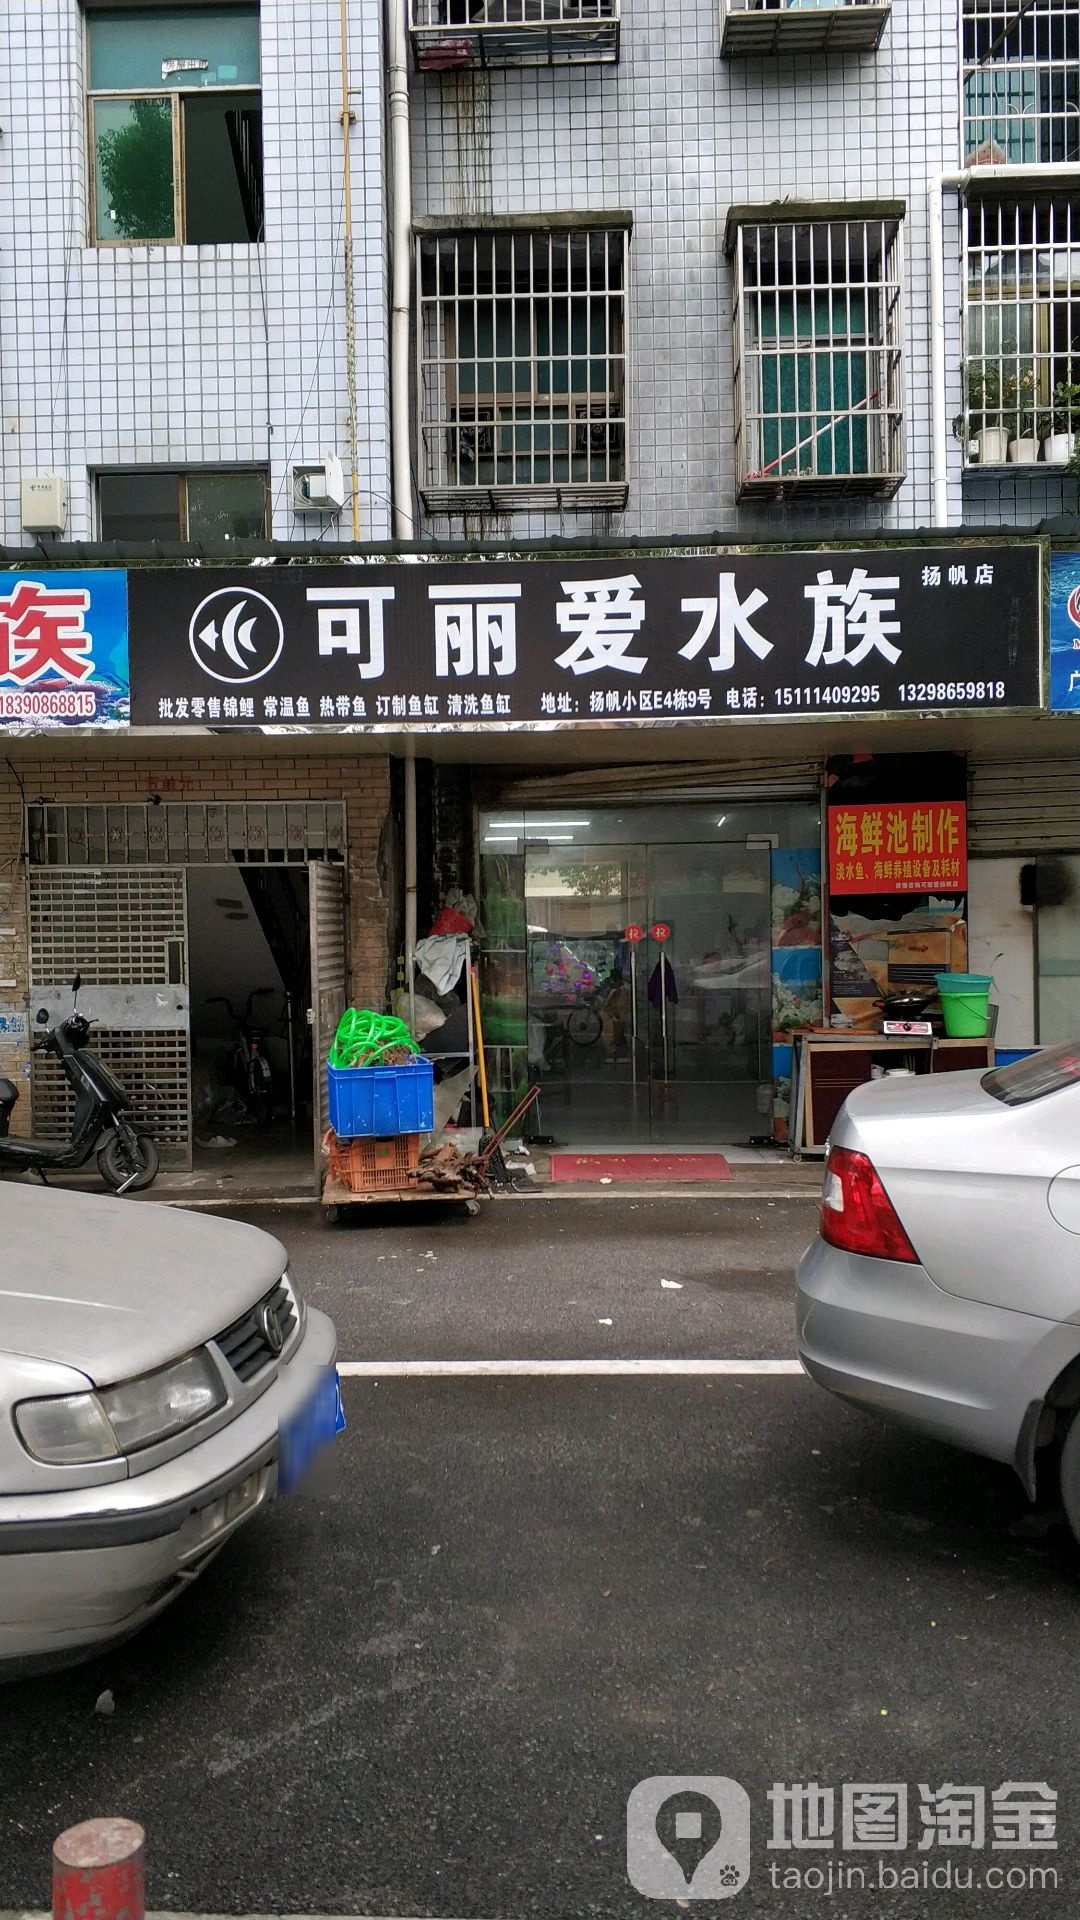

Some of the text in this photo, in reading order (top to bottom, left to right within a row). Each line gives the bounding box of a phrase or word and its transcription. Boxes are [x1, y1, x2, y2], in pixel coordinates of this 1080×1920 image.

[922, 564, 994, 586] 扬帆店
[306, 568, 903, 680] 可丽爱水族
[158, 696, 255, 718] 批发零售锦鲤
[263, 695, 311, 718] 常温鱼
[319, 694, 367, 717] 热带鱼
[375, 693, 439, 717] 订制鱼缸
[447, 692, 512, 717] 清洗鱼缸
[898, 681, 1005, 702] 13298659818
[836, 808, 960, 857] 海鲜池制作
[836, 858, 960, 881] 淡水鱼、海鲜养殖设备及耗材
